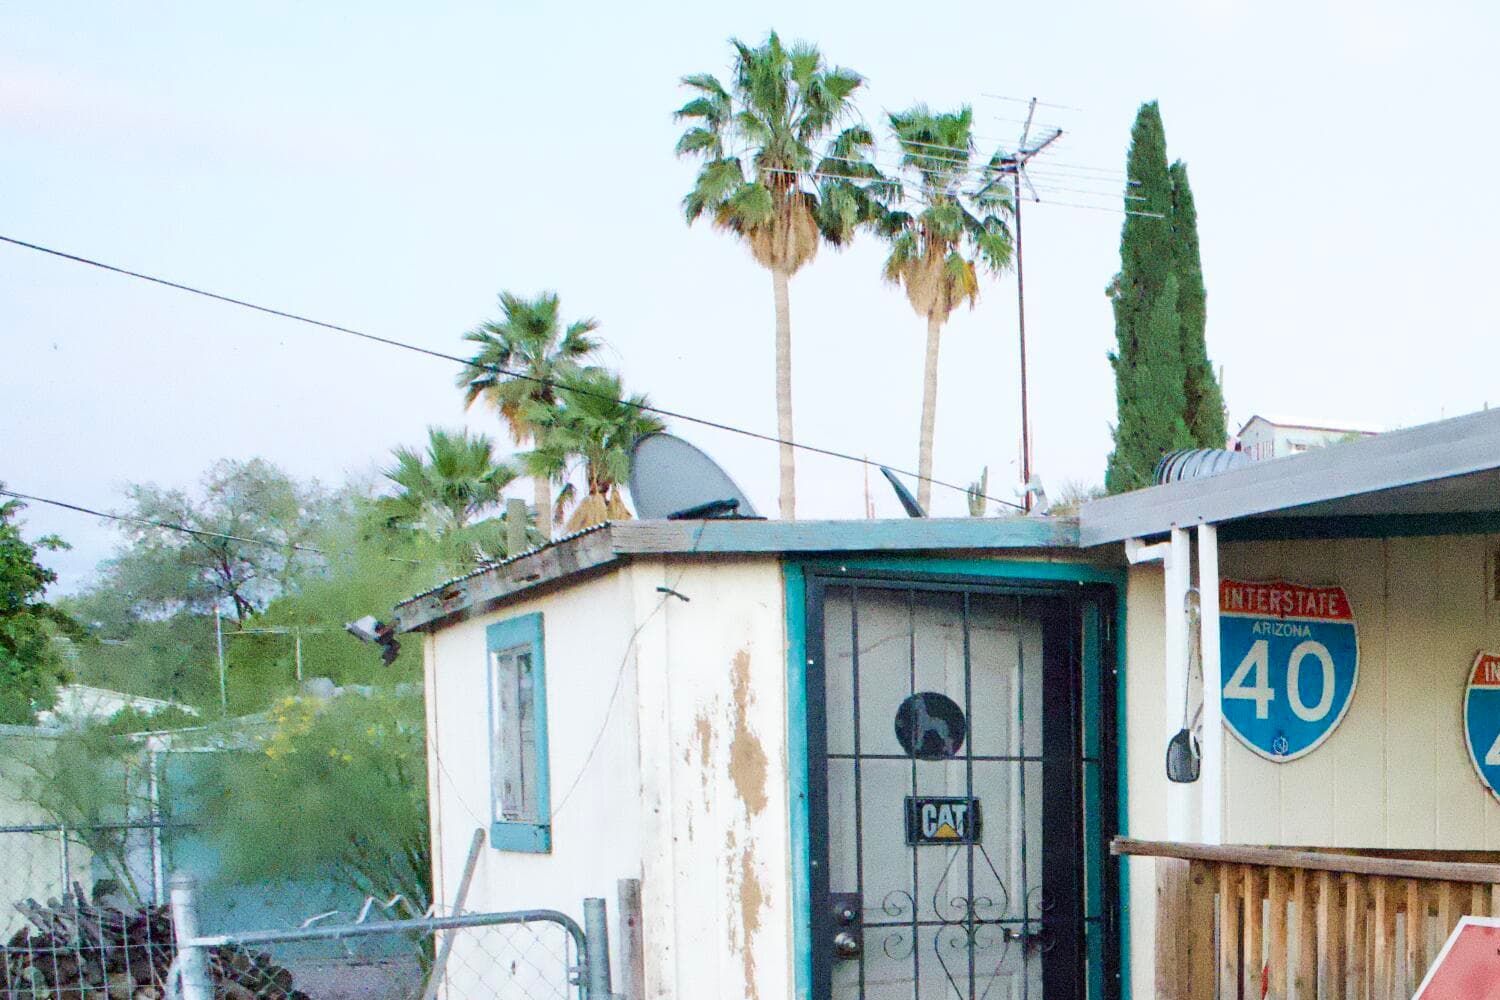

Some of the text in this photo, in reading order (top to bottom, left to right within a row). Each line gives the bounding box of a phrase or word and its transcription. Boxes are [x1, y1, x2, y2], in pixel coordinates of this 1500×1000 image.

[1224, 586, 1340, 616] INTERSTATE
[1252, 621, 1312, 638] ARIZONA
[1223, 639, 1336, 723] 40
[921, 803, 968, 839] CAT
